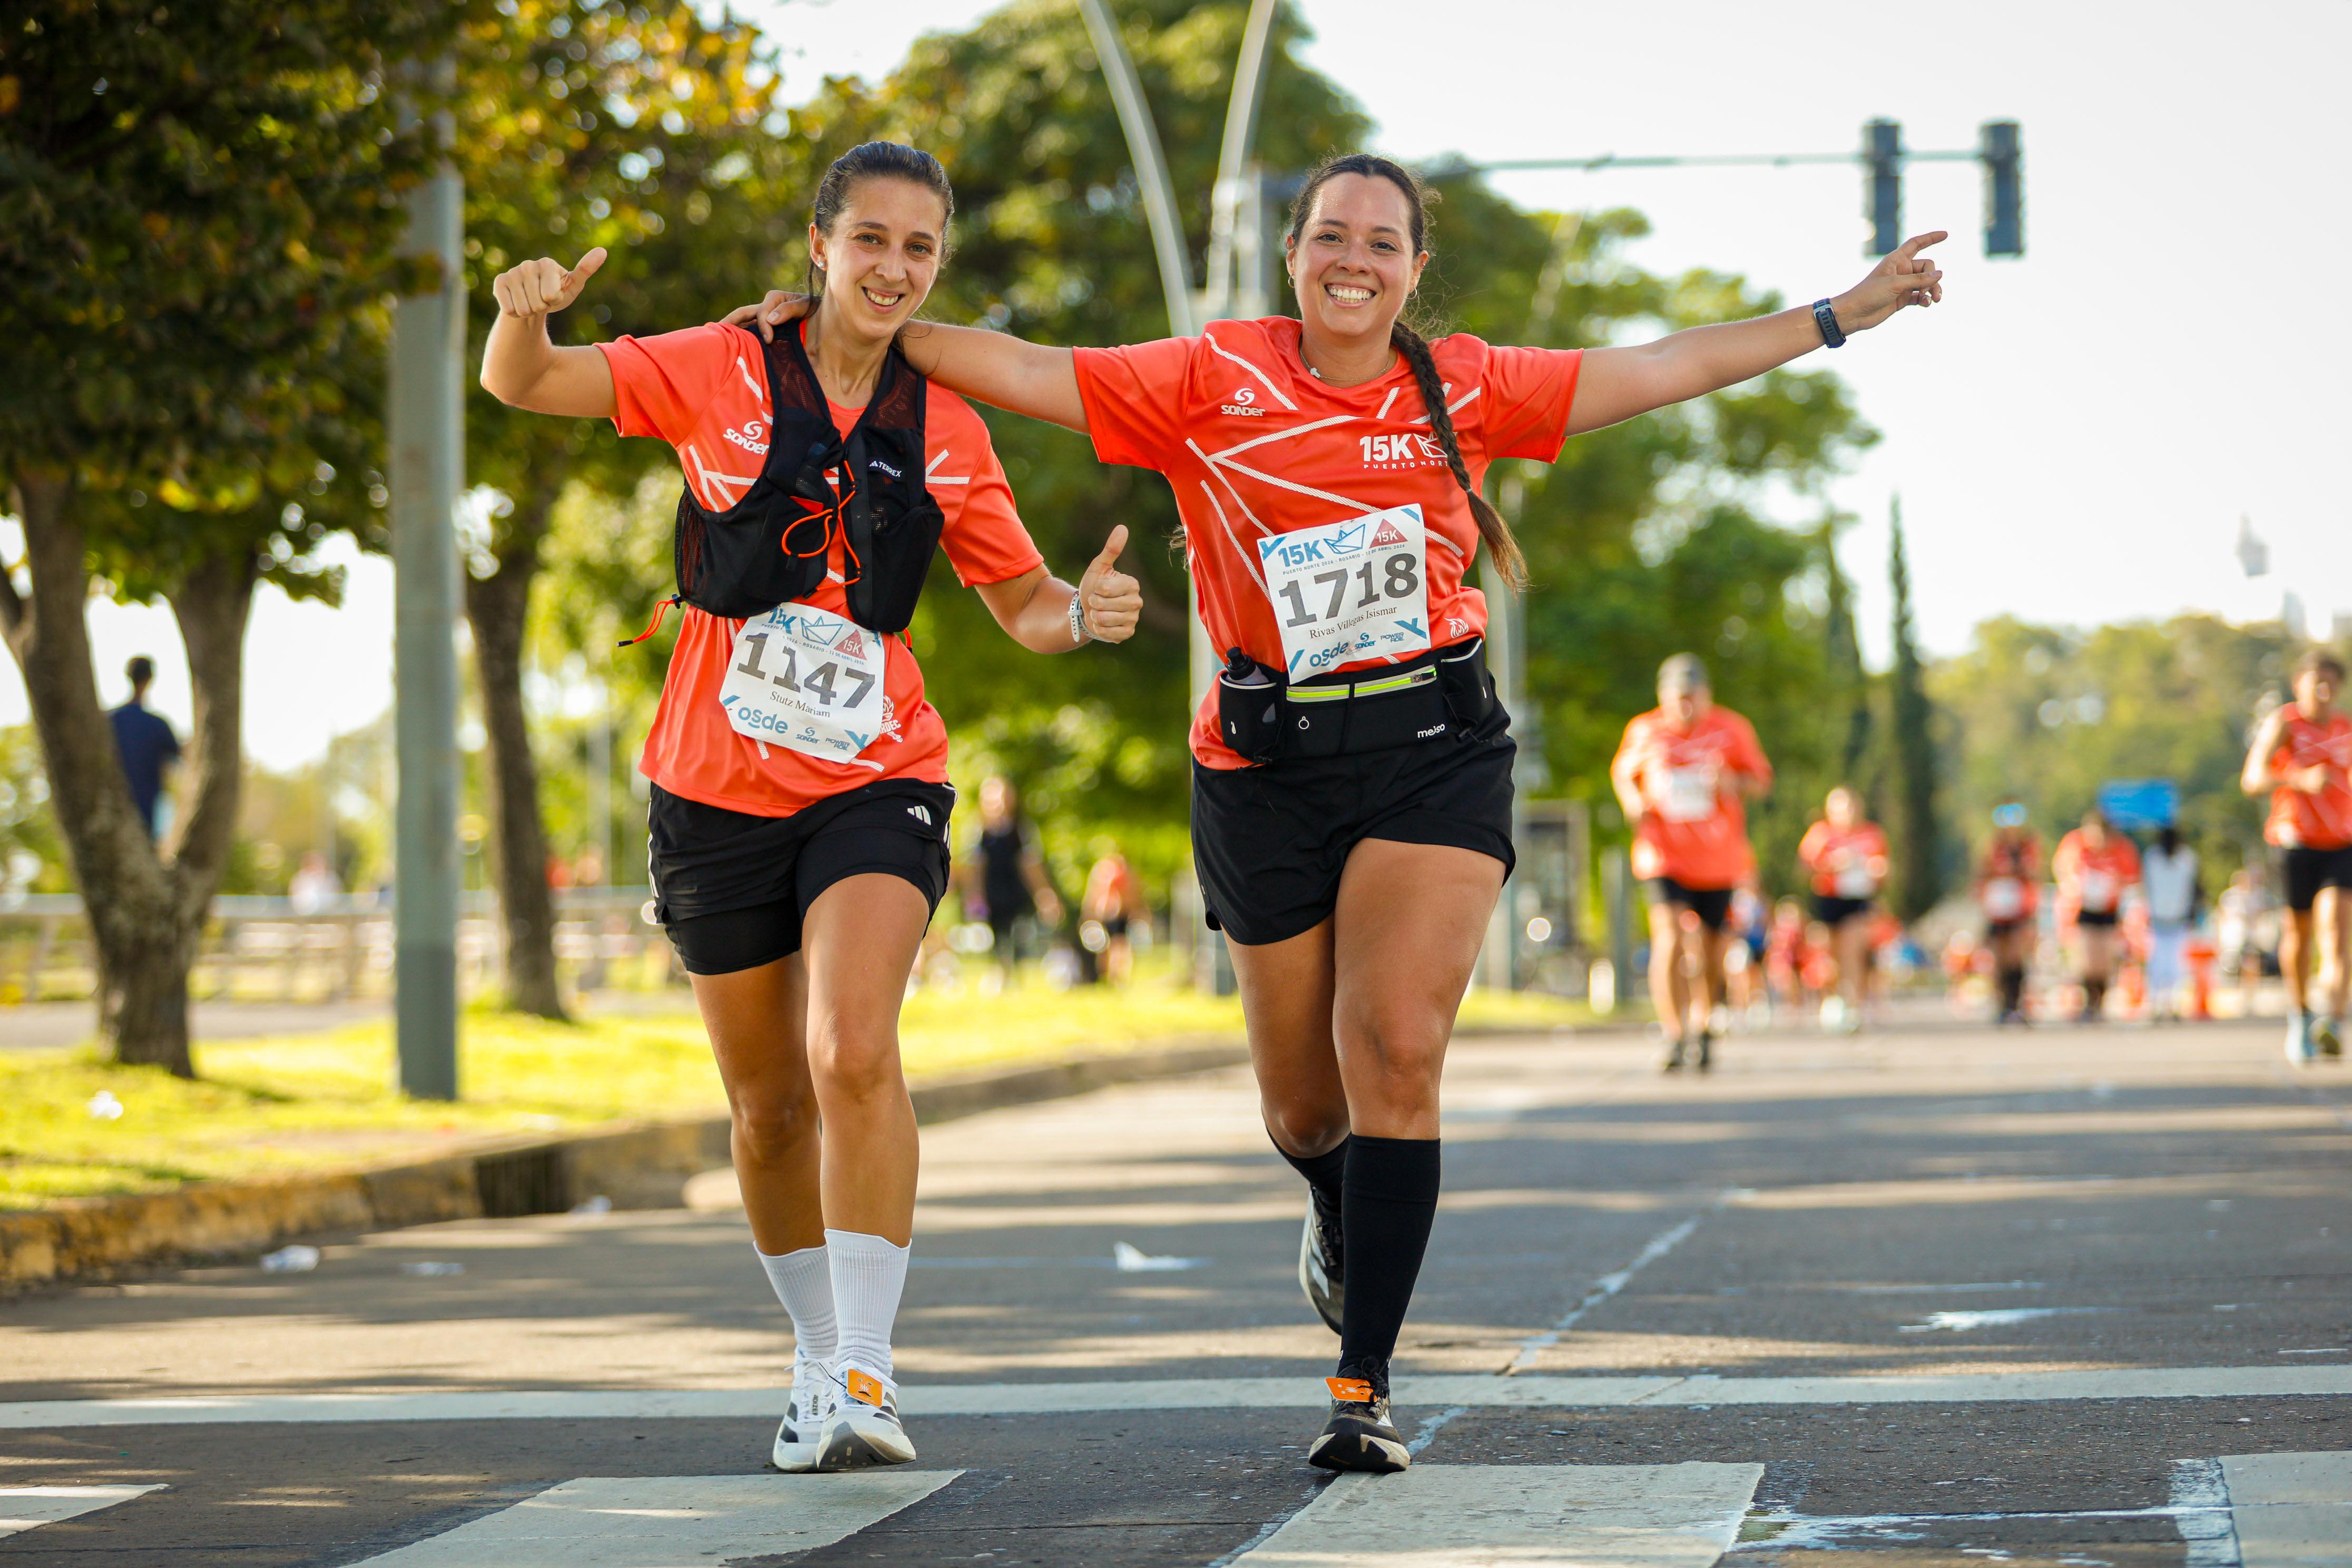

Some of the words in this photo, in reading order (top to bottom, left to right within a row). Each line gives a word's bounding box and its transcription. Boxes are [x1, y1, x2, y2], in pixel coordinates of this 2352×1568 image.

[1359, 433, 1414, 462] 15K
[879, 461, 902, 477] TERREX
[1377, 529, 1398, 543] 15K
[1278, 540, 1324, 567] 15K
[1339, 553, 1360, 562] ROSARIO
[1279, 553, 1418, 628] 1718
[768, 606, 797, 634] 15K
[1310, 626, 1335, 639] Rivas
[1337, 614, 1364, 631] Villegas
[1366, 606, 1397, 619] Isismar
[802, 642, 825, 652] ROSARIO
[843, 639, 861, 654] 15K
[1380, 632, 1404, 640] POWER
[1309, 641, 1349, 667] osde
[737, 632, 876, 708] 1147
[769, 691, 793, 707] Stutz
[795, 700, 830, 718] Mariam
[738, 707, 788, 734] osde
[880, 719, 901, 734] RDEC
[826, 738, 850, 746] POWER
